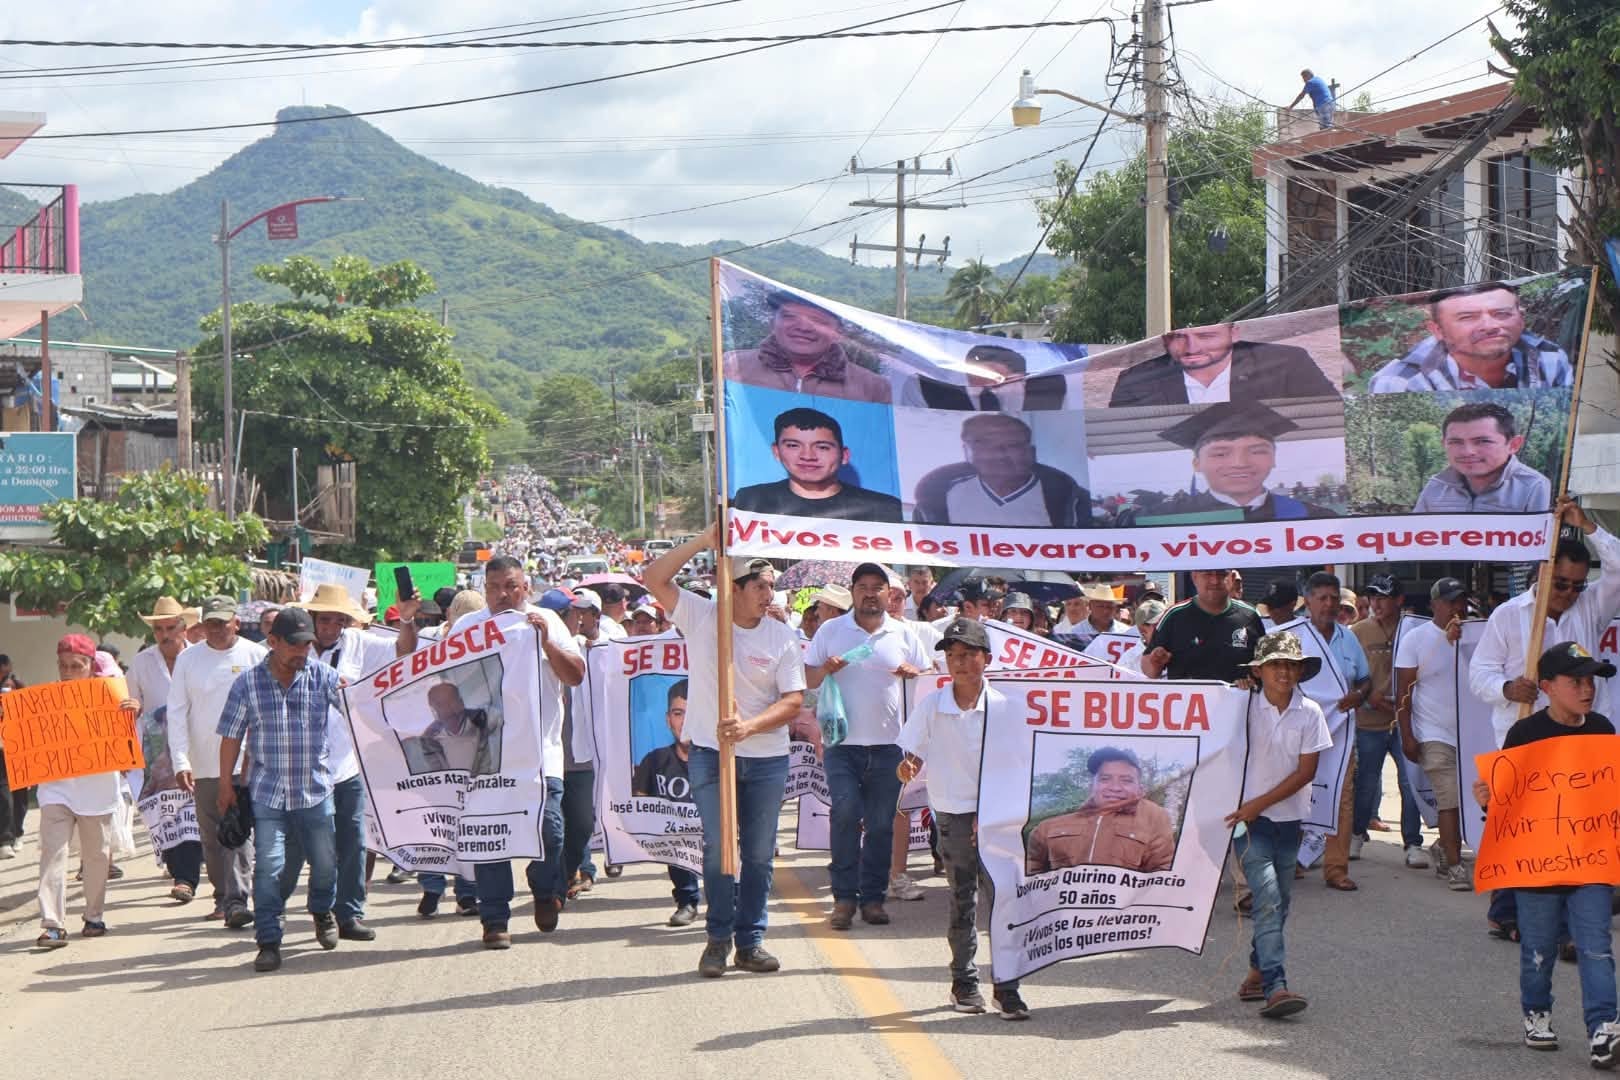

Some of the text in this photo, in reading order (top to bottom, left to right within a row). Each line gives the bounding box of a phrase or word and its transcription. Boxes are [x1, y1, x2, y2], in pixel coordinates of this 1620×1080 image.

[11, 477, 59, 487] Domingo
[727, 516, 1547, 562] ¡Vivos se los llevaron, vivos los queremos!
[373, 620, 506, 697] SE BUSCA
[623, 645, 654, 675] SE
[999, 638, 1036, 669] SE
[1026, 690, 1211, 731] SE BUSCA
[2, 713, 80, 755] SIERRA
[802, 756, 815, 764] 50
[396, 774, 442, 791] Nicolás
[423, 812, 456, 826] ¡Vivos
[610, 801, 632, 813] José
[430, 827, 506, 852] vivos eremos!
[665, 821, 676, 833] 24
[1480, 863, 1506, 880] en
[1516, 844, 1608, 874] nuestros
[1062, 869, 1116, 885] Quirino
[1120, 873, 1186, 888] Atanacio
[1058, 890, 1116, 905] 50 años
[1023, 913, 1161, 948] ¡Vivos se los llevaron,
[1027, 927, 1152, 961] vivos los queremos!
